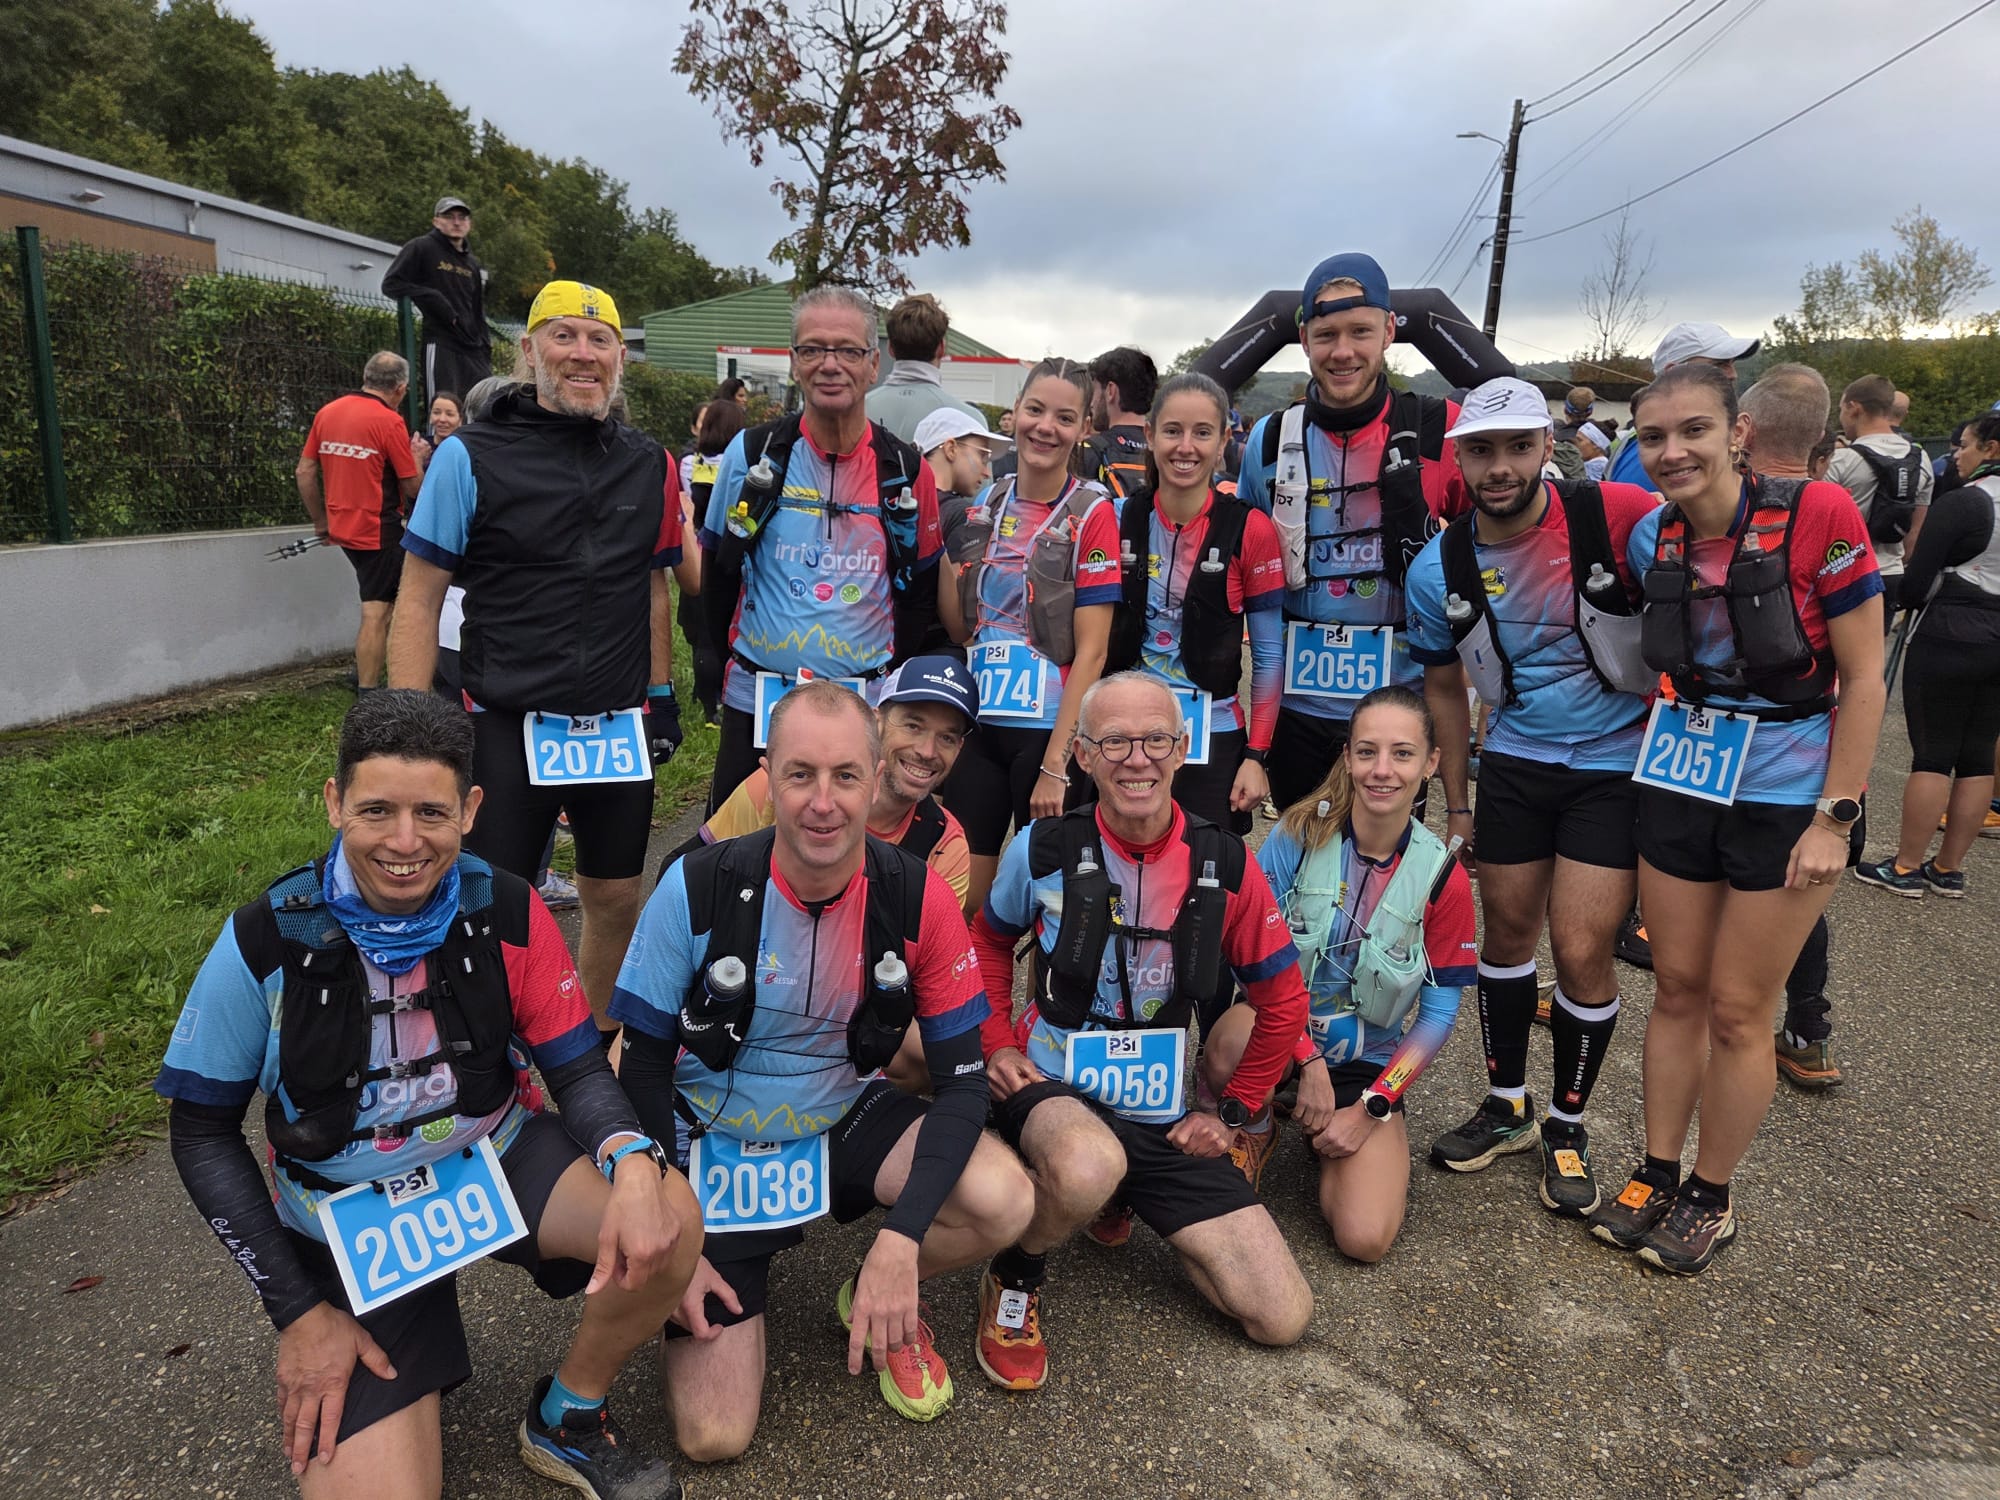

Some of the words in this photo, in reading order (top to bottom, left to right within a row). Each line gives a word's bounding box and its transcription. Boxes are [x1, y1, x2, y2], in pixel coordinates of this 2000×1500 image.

[1297, 649, 1376, 691] 2055
[540, 737, 634, 776] 2075
[1647, 732, 1734, 792] 2051
[1078, 1062, 1168, 1108] 2058
[705, 1159, 814, 1219] 2038
[211, 1217, 233, 1234] Col
[355, 1183, 498, 1292] 2099
